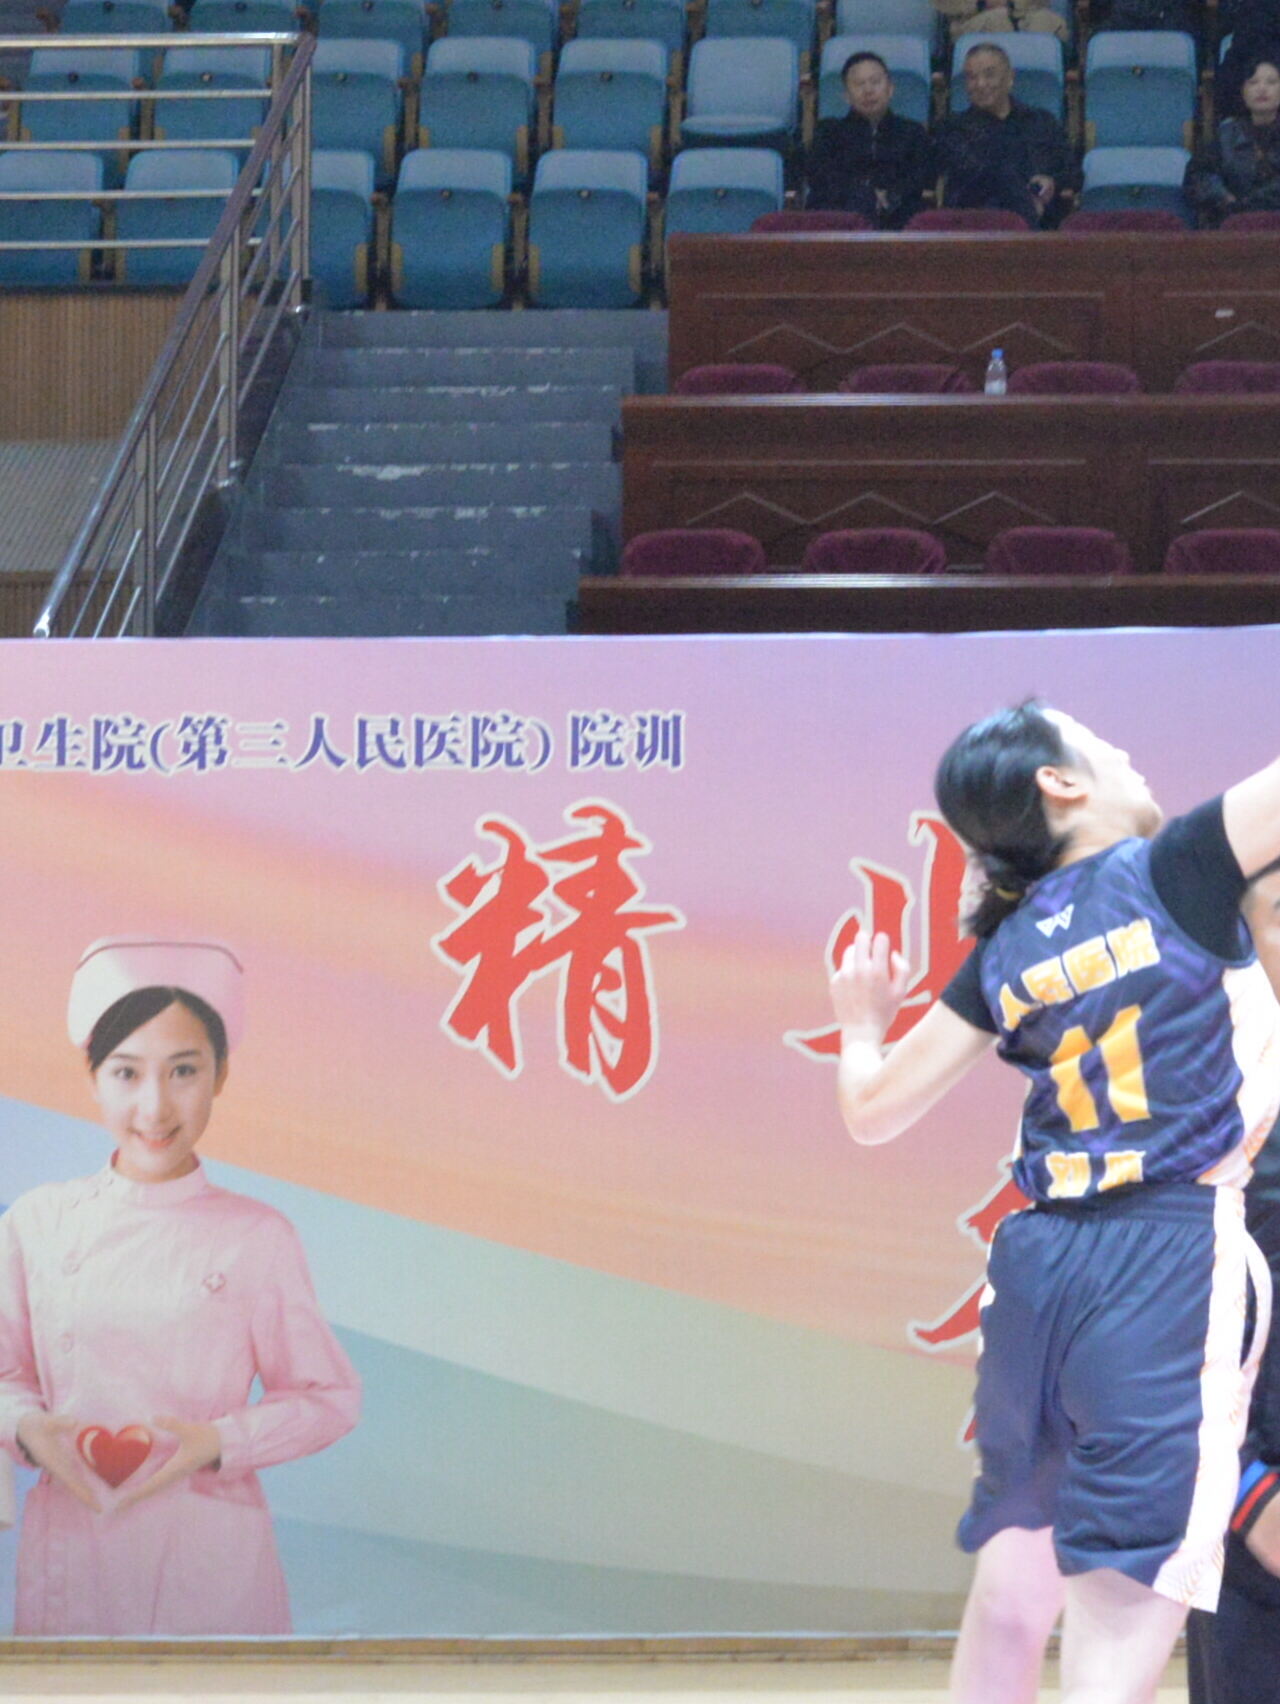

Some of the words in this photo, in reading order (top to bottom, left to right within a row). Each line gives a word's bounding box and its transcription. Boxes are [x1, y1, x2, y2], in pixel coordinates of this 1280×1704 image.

[567, 712, 685, 771] 院训
[434, 799, 686, 1102] 精
[999, 917, 1161, 1031] 人民医院
[1050, 1004, 1151, 1133] 11
